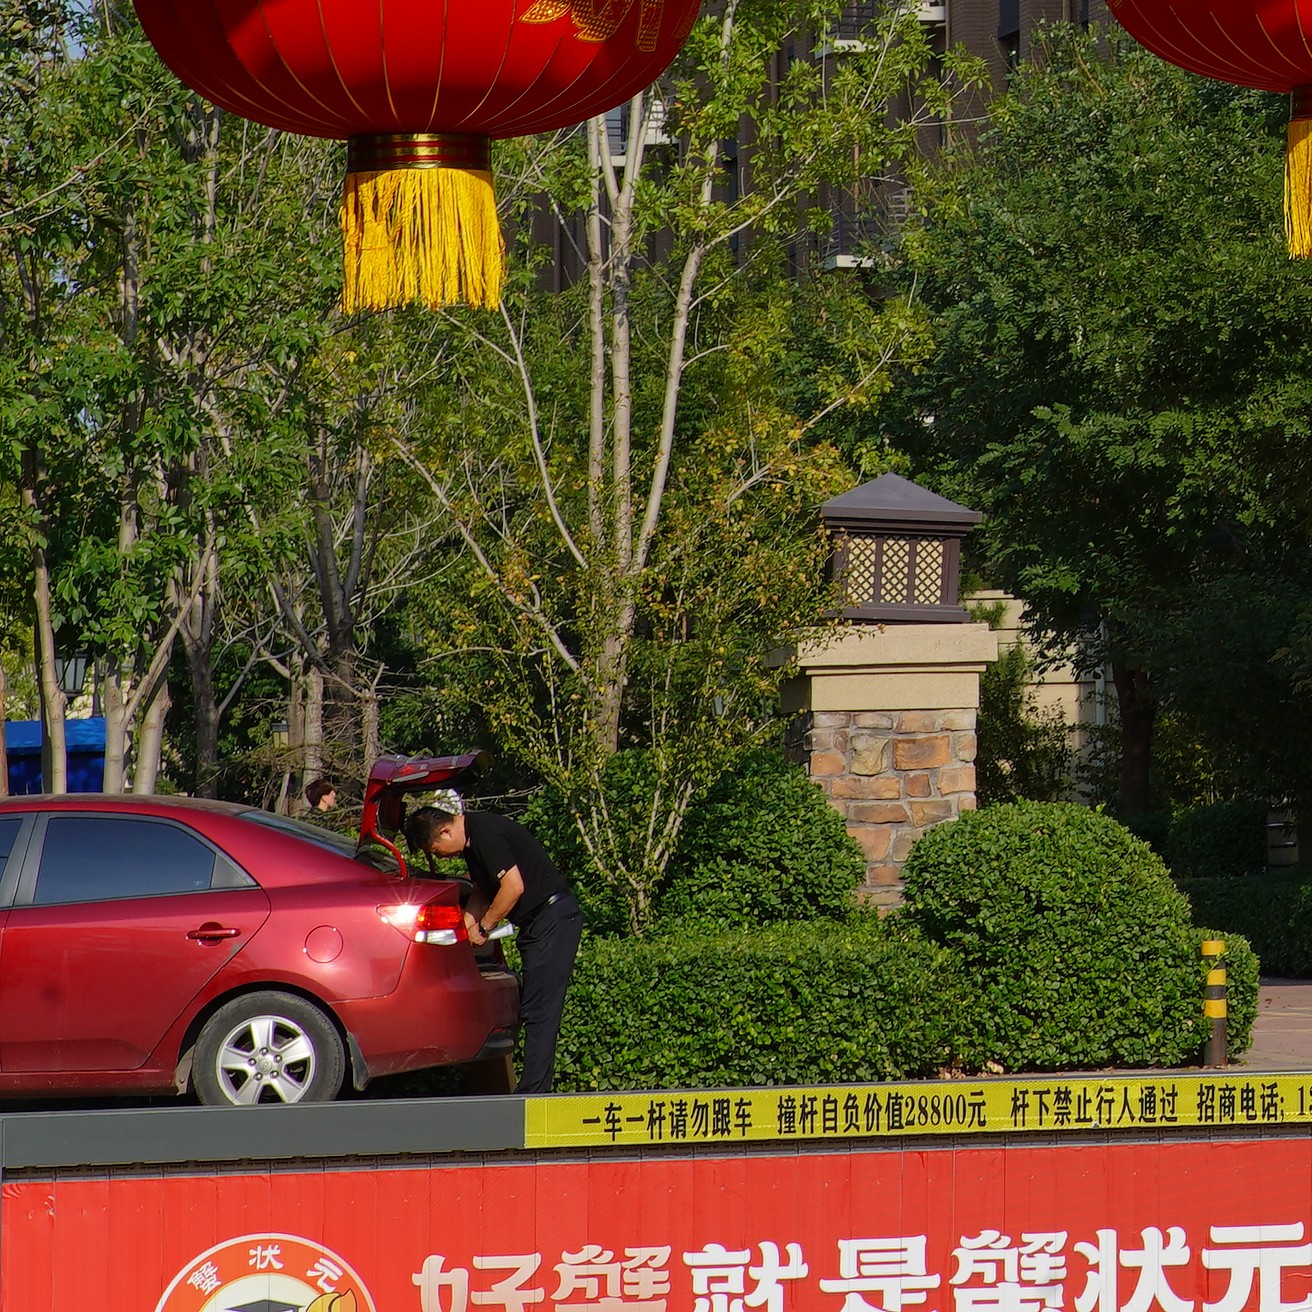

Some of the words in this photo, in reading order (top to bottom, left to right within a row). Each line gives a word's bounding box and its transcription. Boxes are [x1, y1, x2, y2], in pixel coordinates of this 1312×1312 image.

[581, 1095, 754, 1142] 一车一杆请勿跟车
[776, 1088, 987, 1135] 撞杆自负价值28800元
[1010, 1082, 1179, 1128] 杆下禁止行人通过
[187, 1244, 344, 1296] 蟹状元
